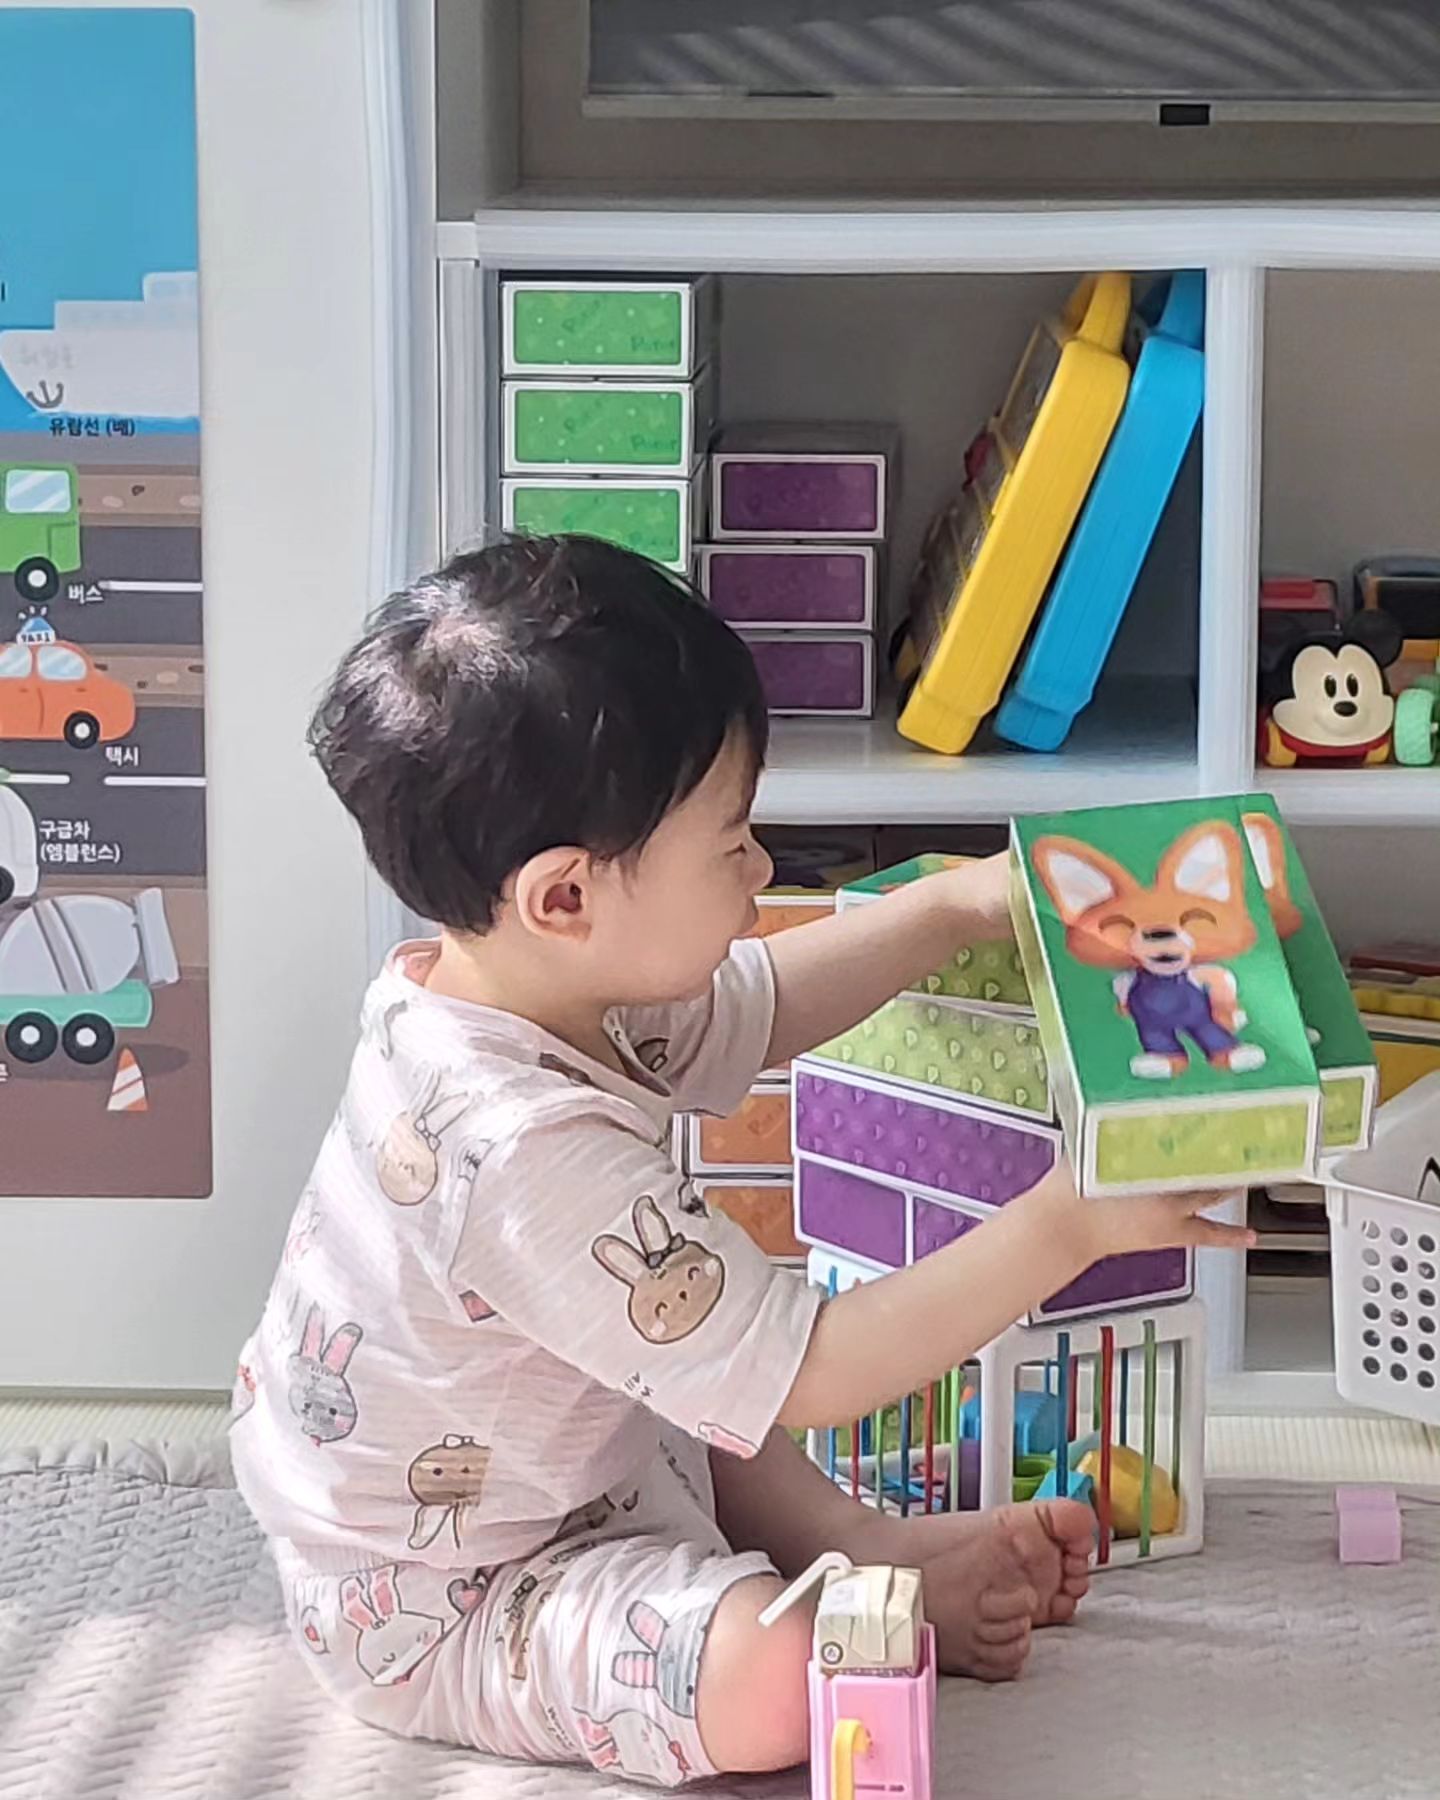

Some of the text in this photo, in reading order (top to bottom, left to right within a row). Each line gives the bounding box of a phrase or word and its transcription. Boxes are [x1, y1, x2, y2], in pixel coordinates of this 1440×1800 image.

[68, 584, 104, 604] 버스
[105, 746, 139, 767] 택시
[40, 820, 91, 840] 구급차
